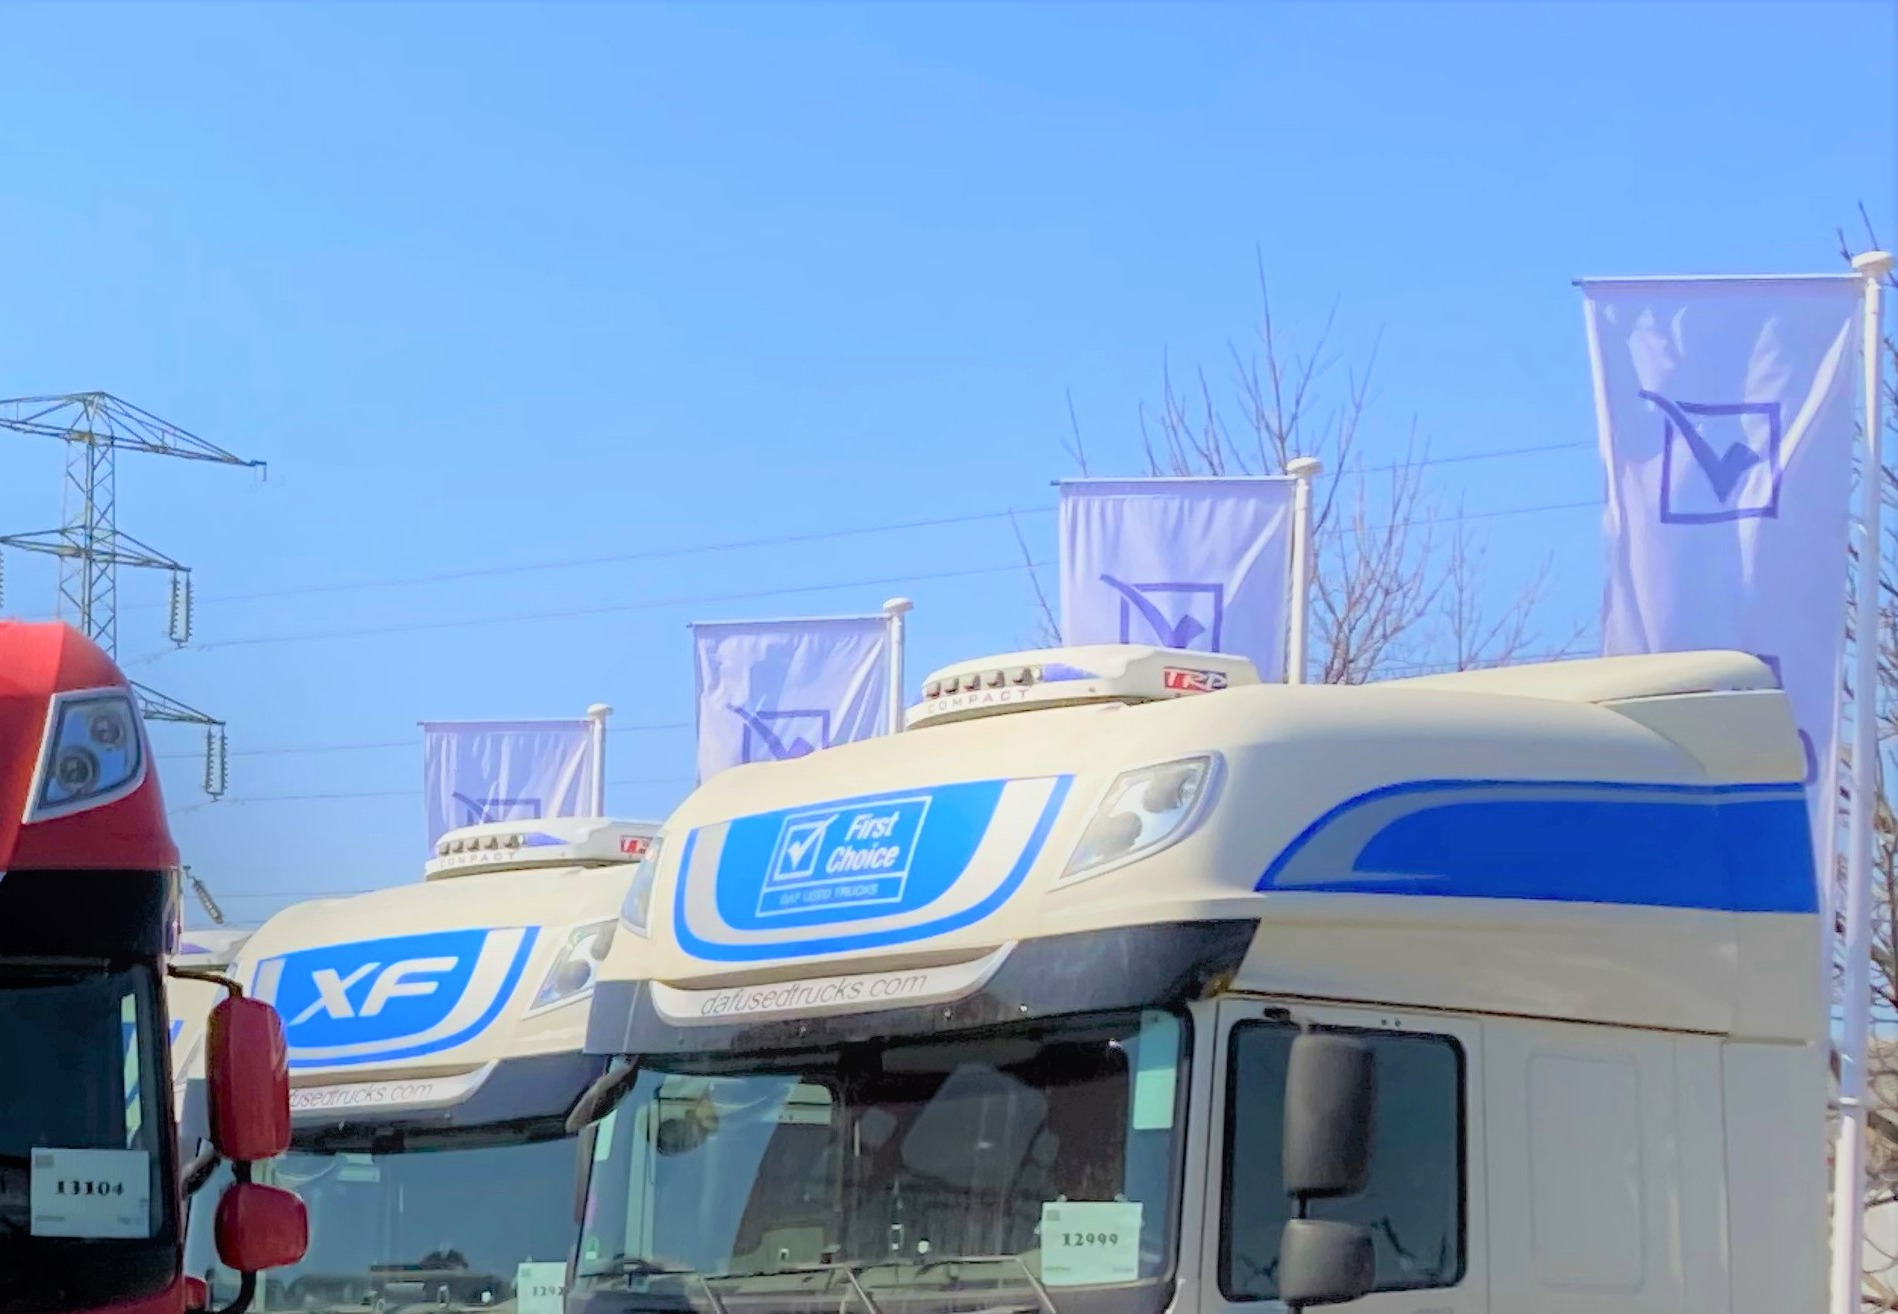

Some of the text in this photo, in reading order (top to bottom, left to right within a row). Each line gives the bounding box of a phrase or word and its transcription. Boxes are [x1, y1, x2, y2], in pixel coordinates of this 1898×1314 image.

[927, 688, 1030, 713] COMPACT
[844, 810, 901, 842] First
[825, 842, 900, 874] Choice
[287, 956, 459, 1026] XF
[701, 975, 928, 1016] dafusedtruckscom
[55, 1180, 124, 1196] 13104
[1062, 1232, 1119, 1247] 12999
